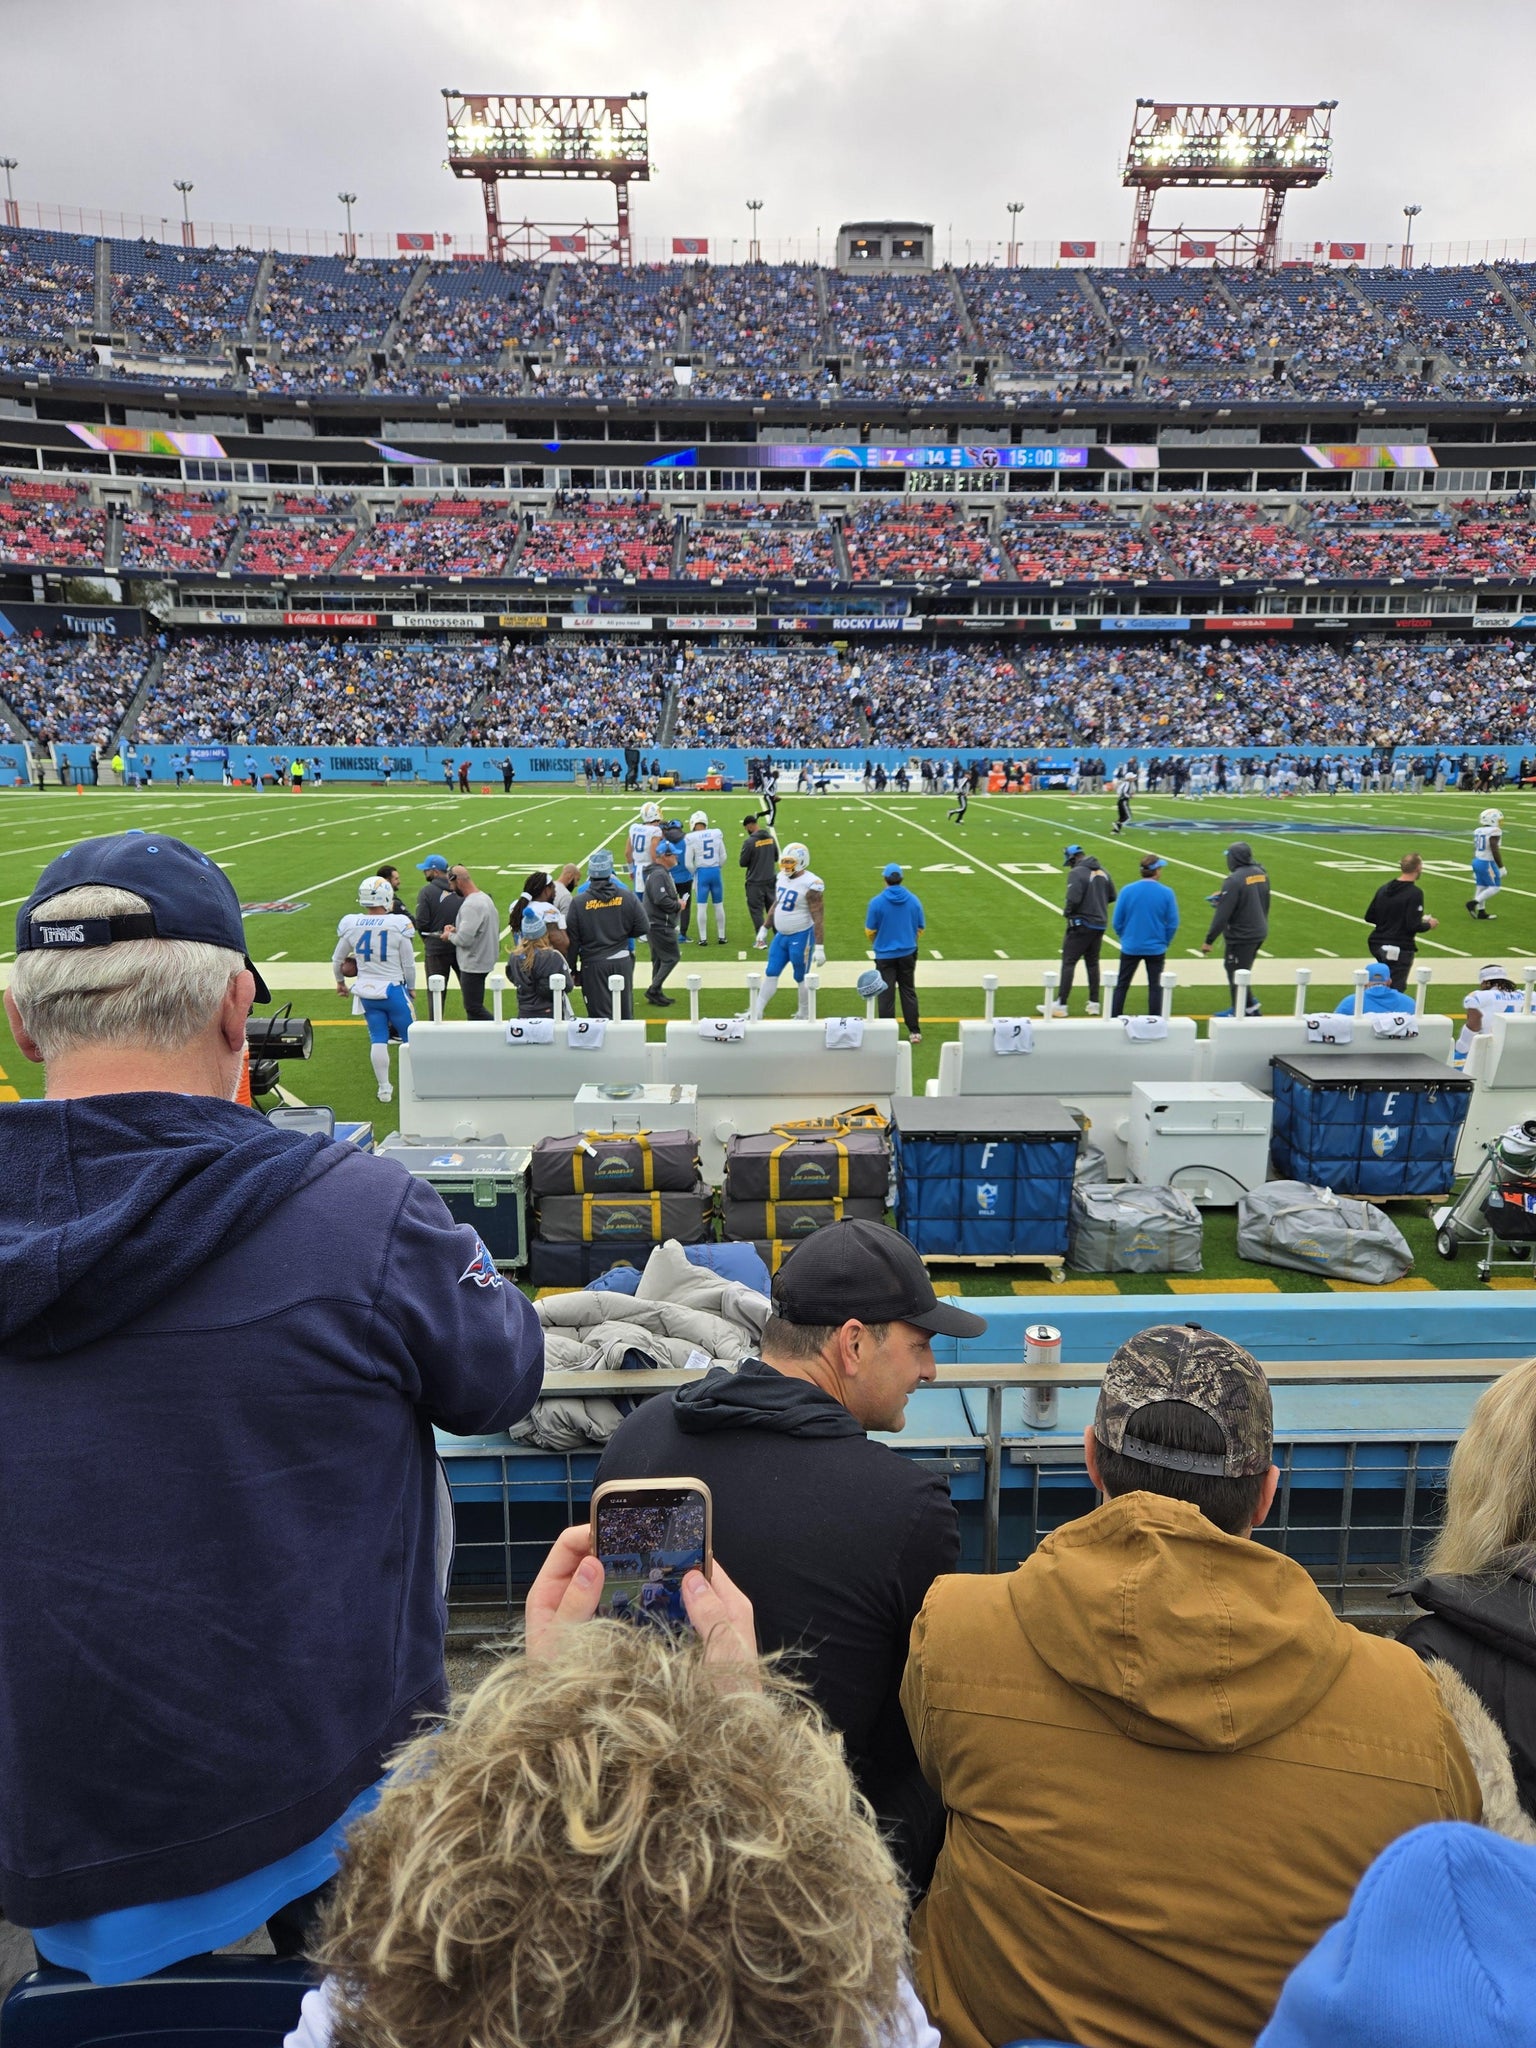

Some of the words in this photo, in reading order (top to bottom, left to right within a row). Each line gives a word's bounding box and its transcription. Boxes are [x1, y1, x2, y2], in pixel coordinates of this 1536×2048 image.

[886, 450, 896, 464] 7
[928, 450, 945, 464] 14
[1010, 450, 1053, 465] 15:00
[1059, 452, 1081, 463] 2nd
[778, 618, 807, 629] FedEx
[833, 619, 873, 629] ROCKY
[874, 619, 899, 629] LAW
[1396, 619, 1432, 628] verizon
[632, 833, 646, 853] 10
[703, 839, 714, 859] 5
[777, 886, 798, 912] 78
[356, 918, 384, 926] LOVATO
[40, 924, 84, 943] TITANS
[355, 930, 388, 962] 41
[1383, 1091, 1400, 1116] E
[981, 1142, 998, 1169] F
